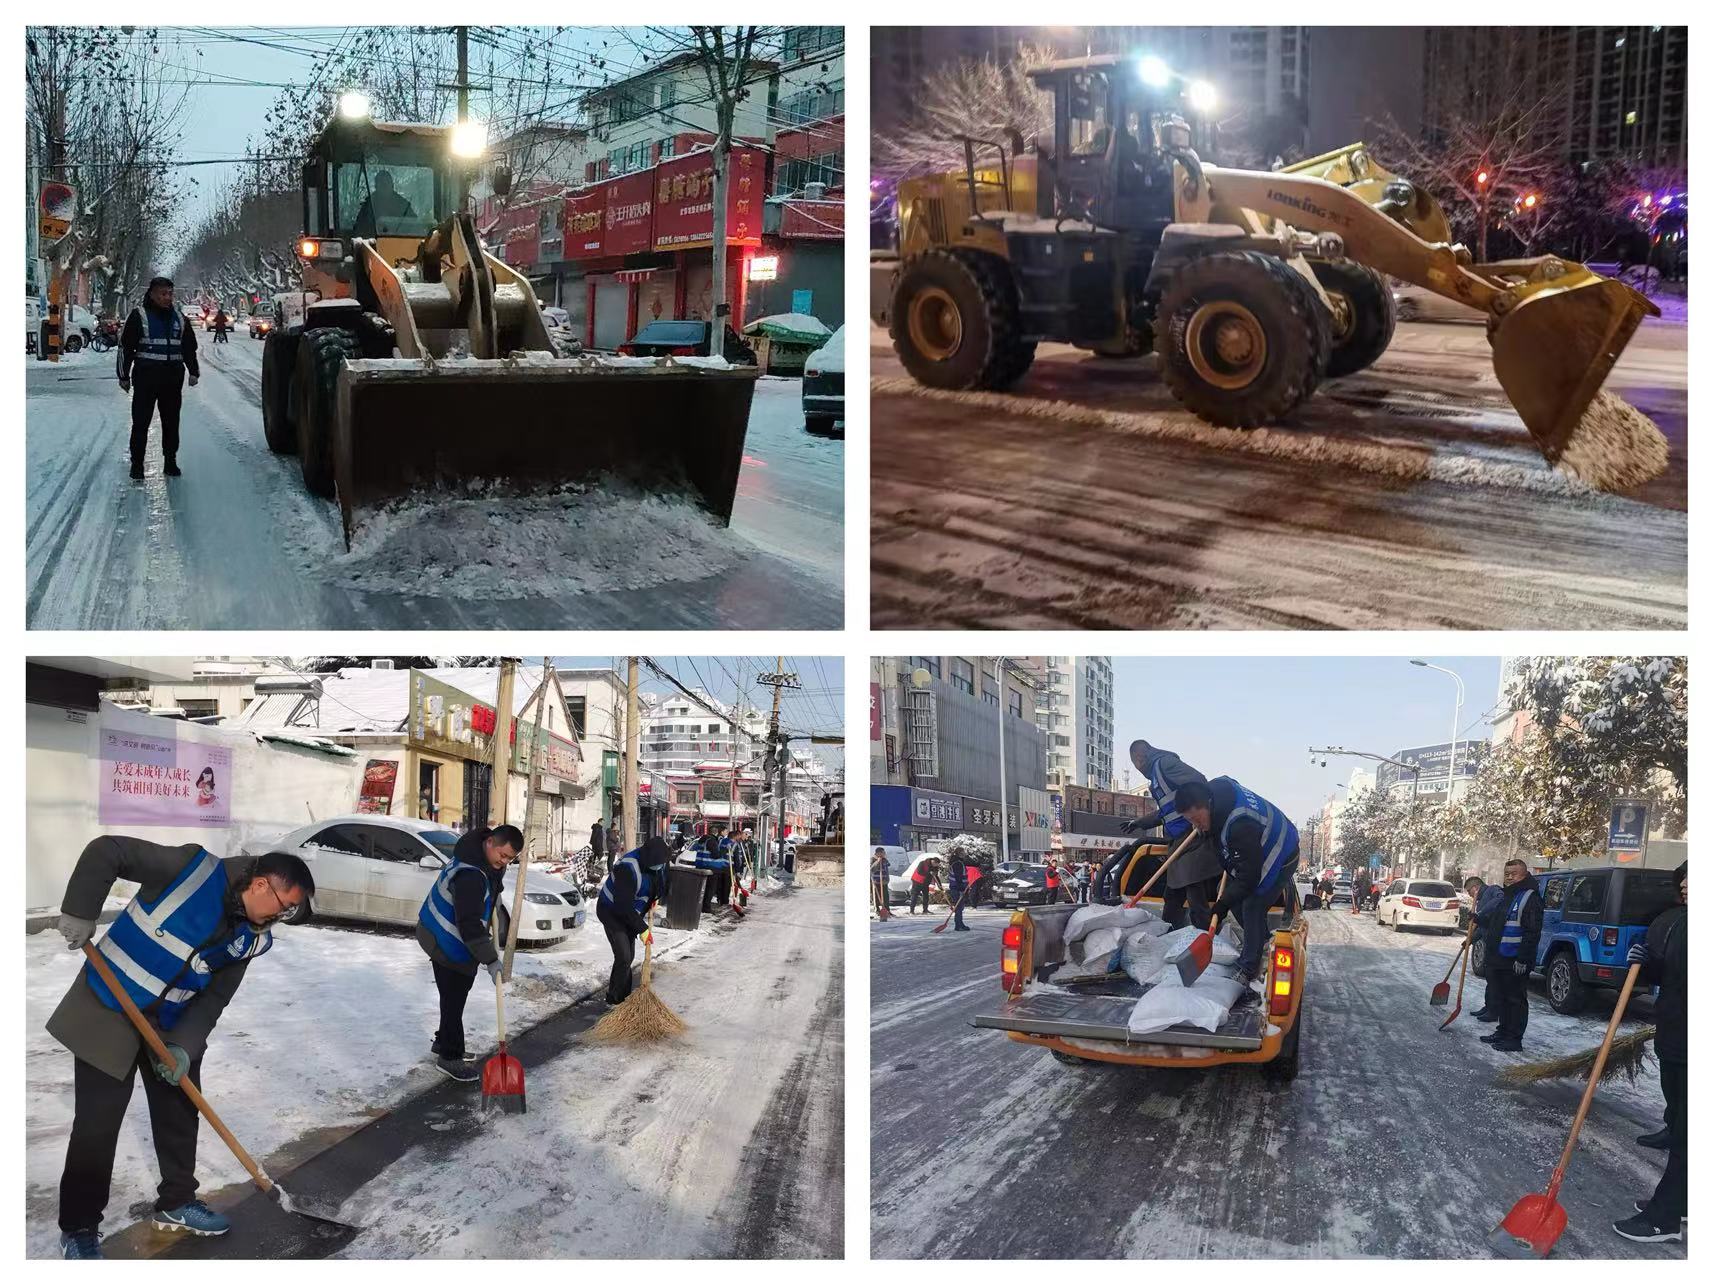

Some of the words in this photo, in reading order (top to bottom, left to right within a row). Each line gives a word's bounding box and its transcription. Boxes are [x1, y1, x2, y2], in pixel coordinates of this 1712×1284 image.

[113, 761, 191, 782] 关爱未成年人成长
[112, 778, 190, 798] 共筑祖国美好未来
[1618, 807, 1636, 833] P
